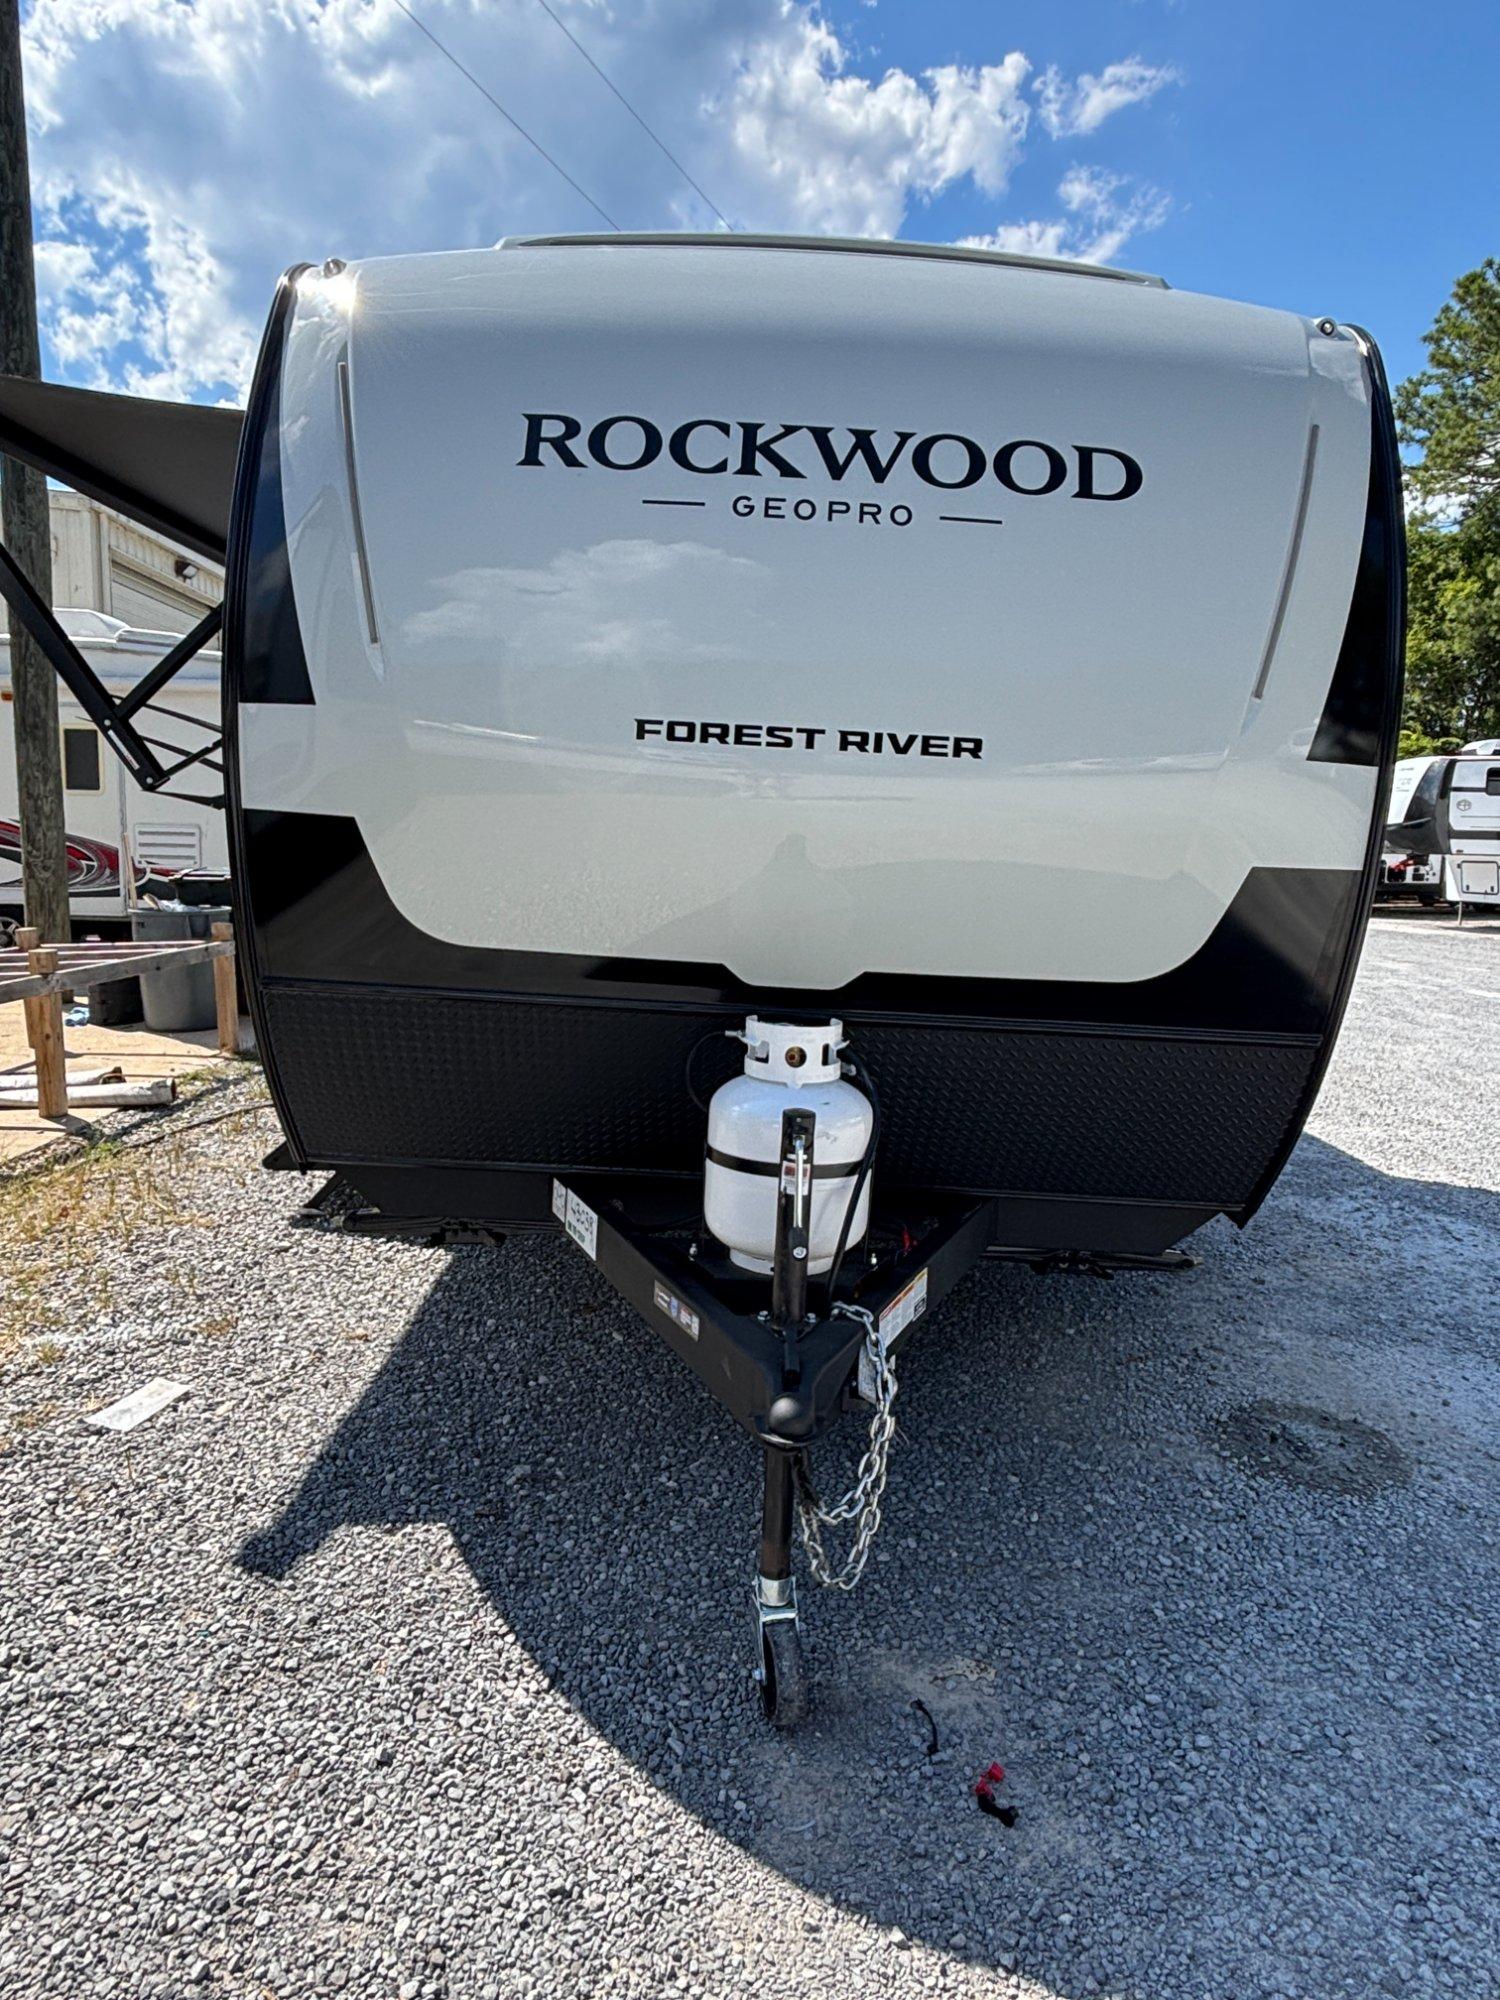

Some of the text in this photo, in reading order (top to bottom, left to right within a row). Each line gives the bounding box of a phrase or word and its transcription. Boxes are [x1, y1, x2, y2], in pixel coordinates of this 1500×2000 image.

[515, 412, 1144, 501] ROCKWOOD
[731, 495, 914, 527] GEOPRO
[633, 717, 984, 760] FOREST RIVER
